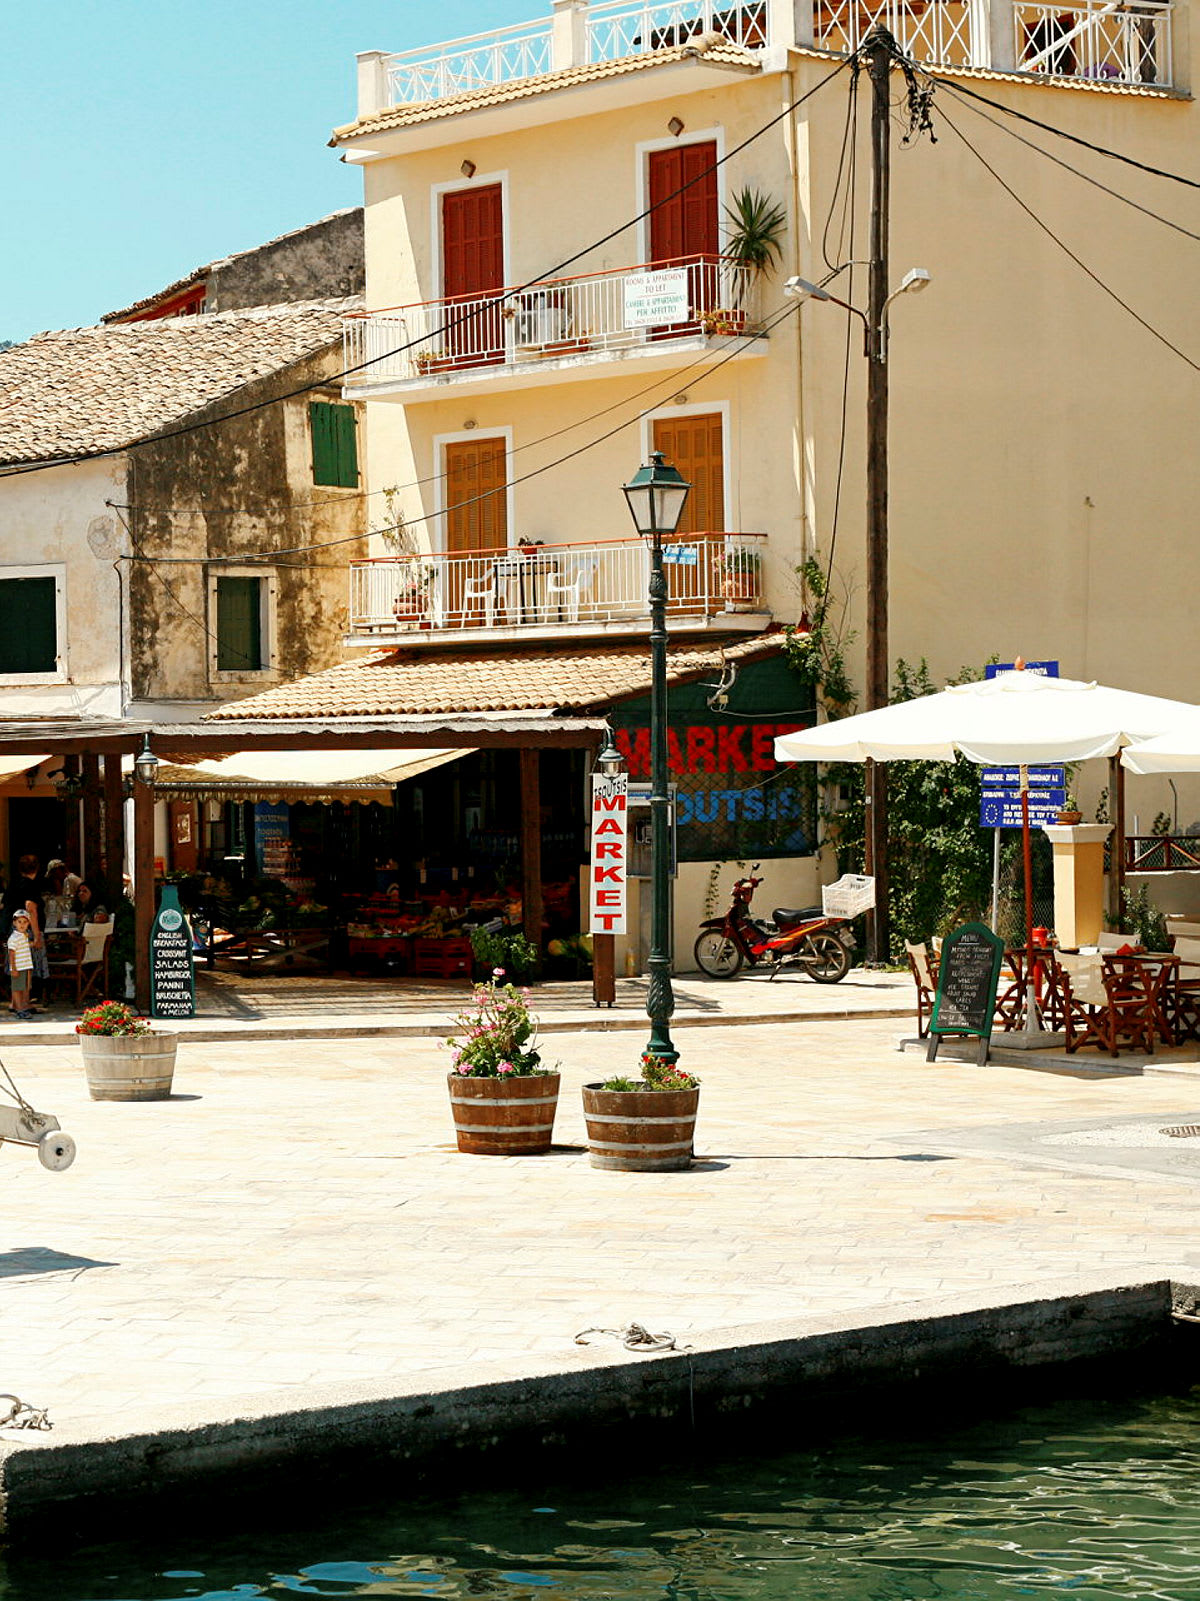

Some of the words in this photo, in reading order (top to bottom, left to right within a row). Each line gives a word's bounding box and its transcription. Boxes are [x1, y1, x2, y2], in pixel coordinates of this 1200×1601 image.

[645, 285, 654, 293] TO
[655, 284, 666, 292] LET
[677, 787, 802, 826] OUTSIS
[593, 795, 626, 930] MARKET
[153, 939, 188, 947] BREAKFAST
[154, 960, 190, 969] SALADS
[154, 970, 192, 980] HAMBURGER
[157, 981, 184, 990] PANINI
